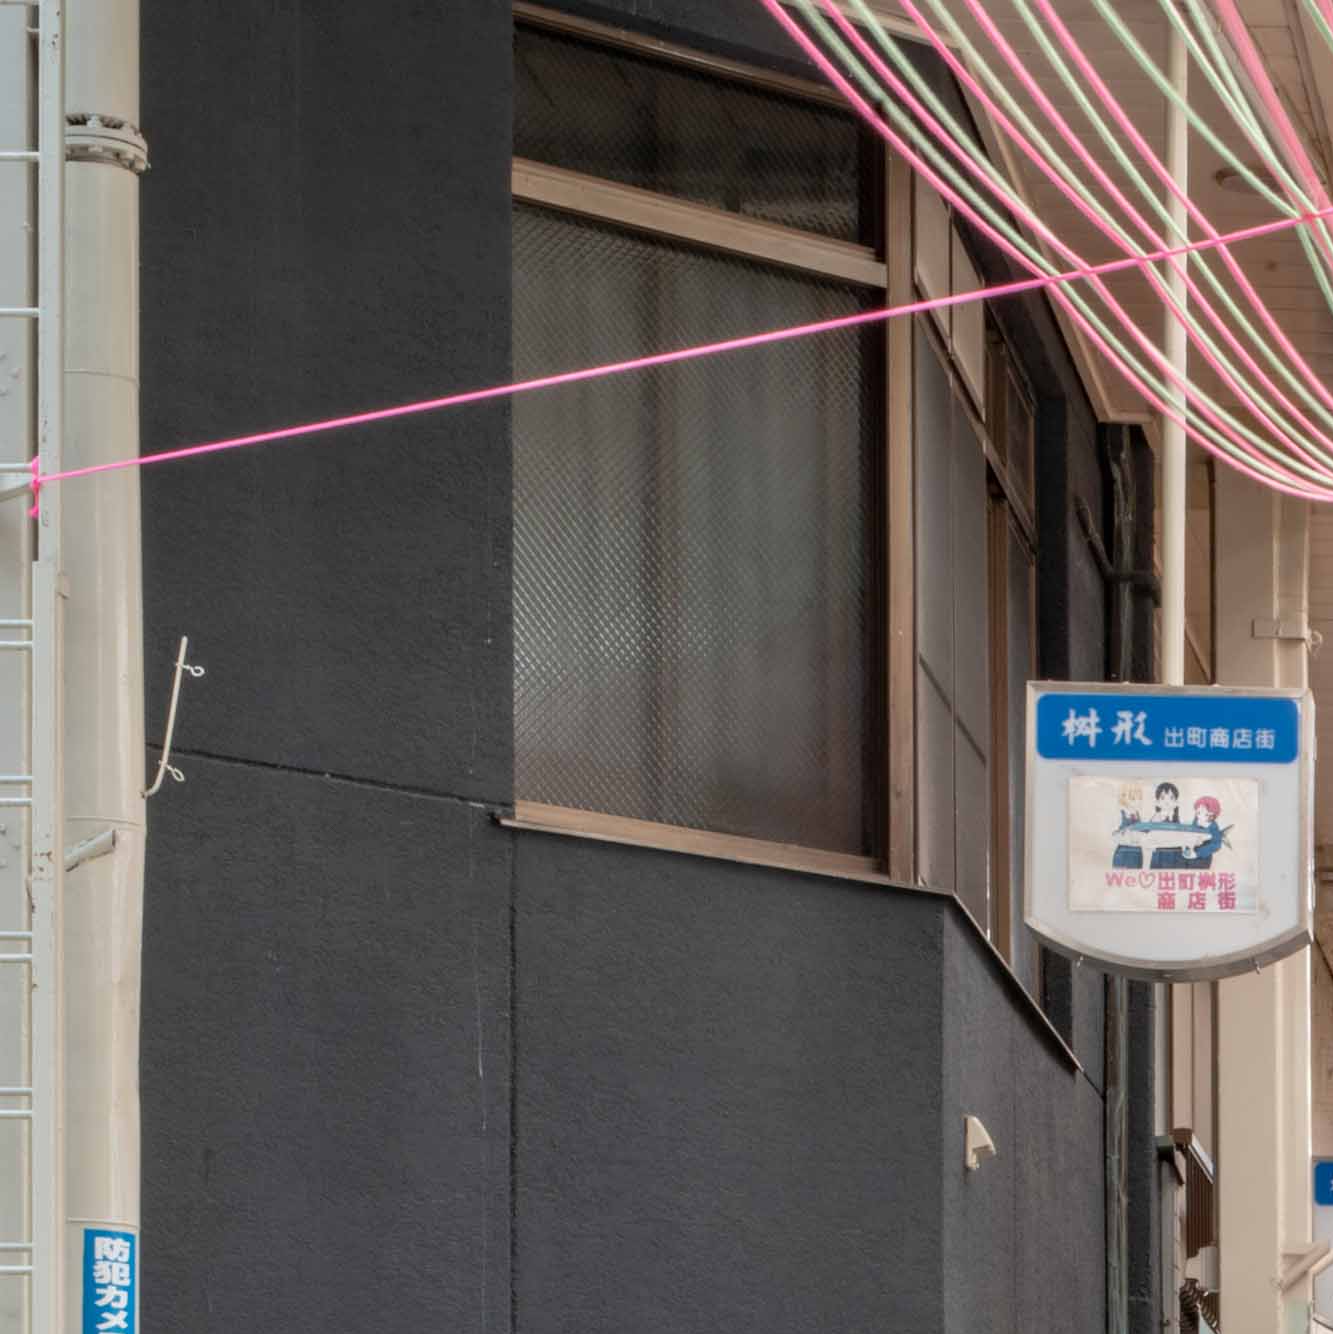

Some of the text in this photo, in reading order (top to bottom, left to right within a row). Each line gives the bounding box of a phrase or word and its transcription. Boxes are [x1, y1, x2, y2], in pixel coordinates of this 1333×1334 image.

[1062, 708, 1275, 749] 桝形 出町商店街
[1157, 892, 1236, 910] 商店街
